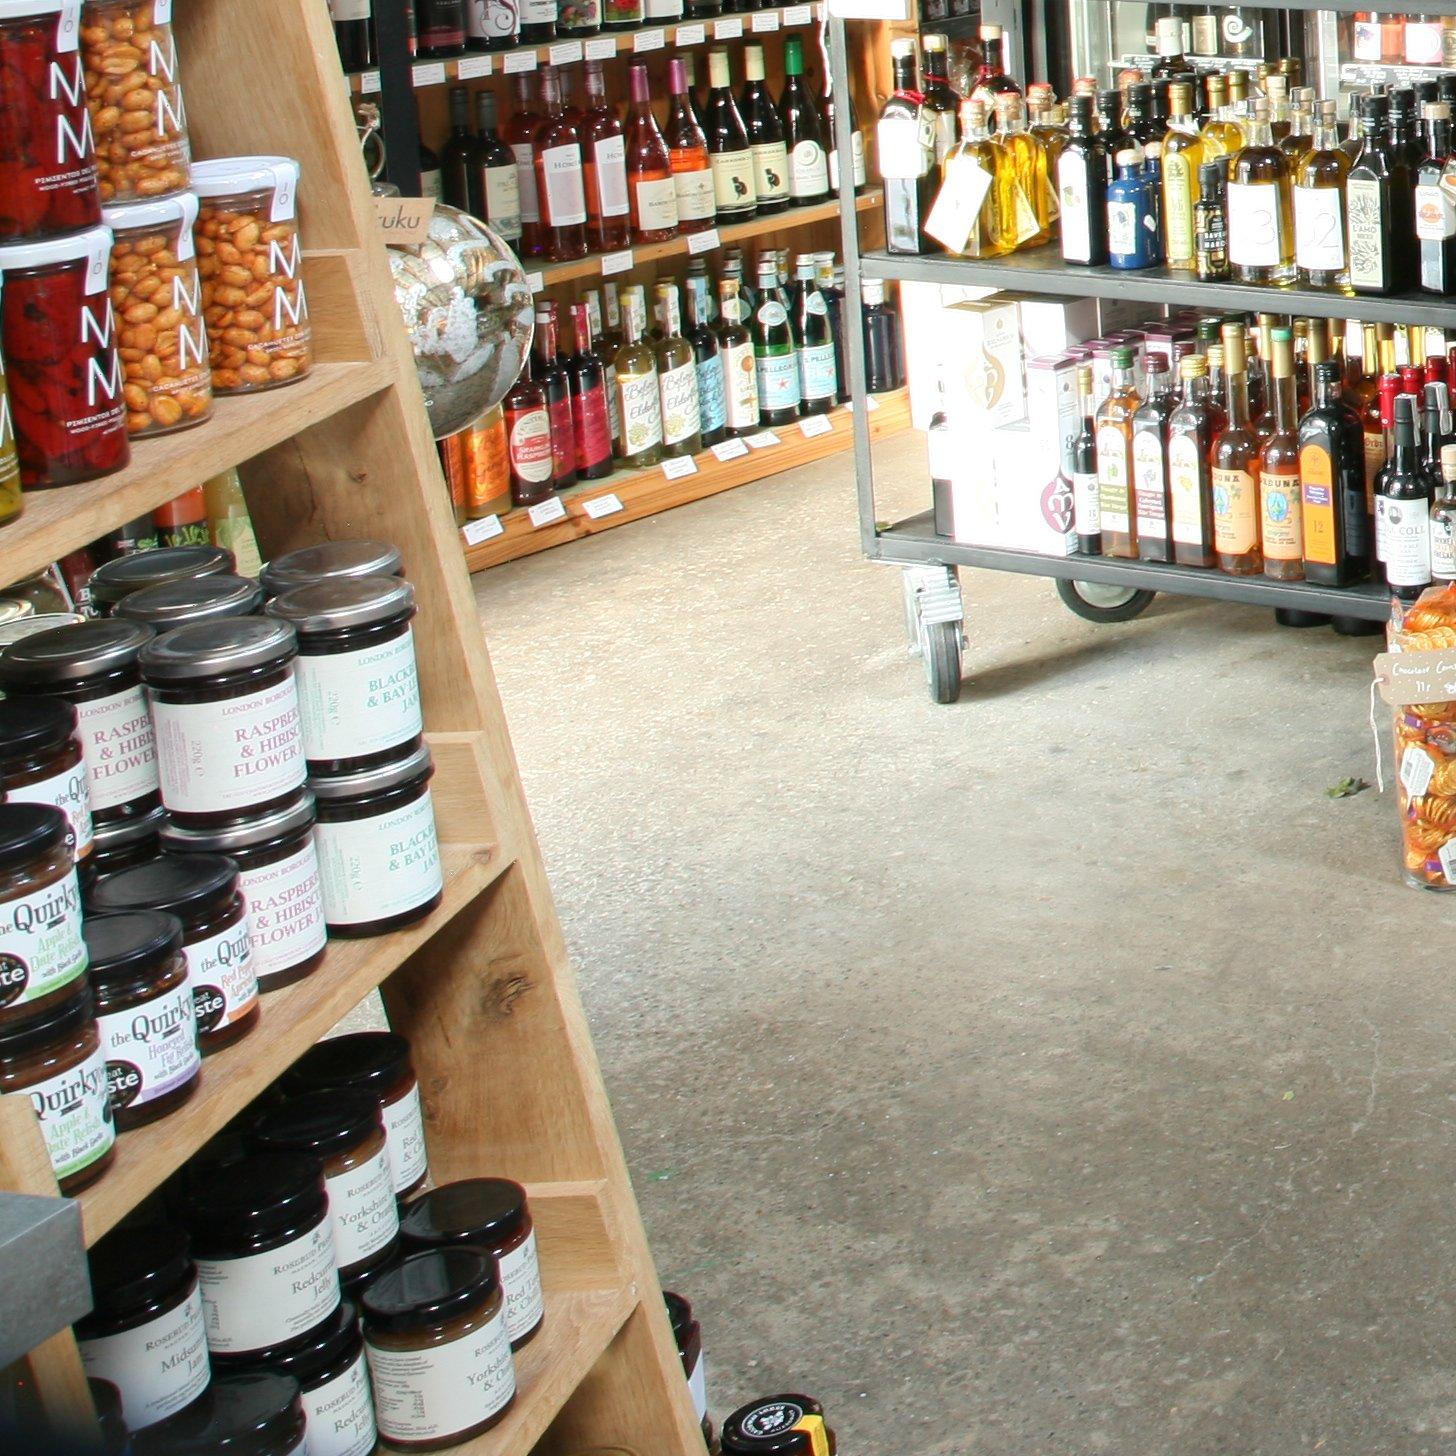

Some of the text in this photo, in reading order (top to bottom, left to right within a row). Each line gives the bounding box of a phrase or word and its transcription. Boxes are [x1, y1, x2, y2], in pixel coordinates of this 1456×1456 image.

[359, 648, 395, 666] LONDON
[381, 683, 408, 705] BAY
[79, 700, 121, 718] LONDON
[221, 697, 263, 716] LONDON
[240, 742, 255, 759] &
[233, 747, 295, 778] FLOWER
[200, 954, 218, 974] the
[111, 1028, 132, 1048] the
[338, 1192, 389, 1227] Yorkshire
